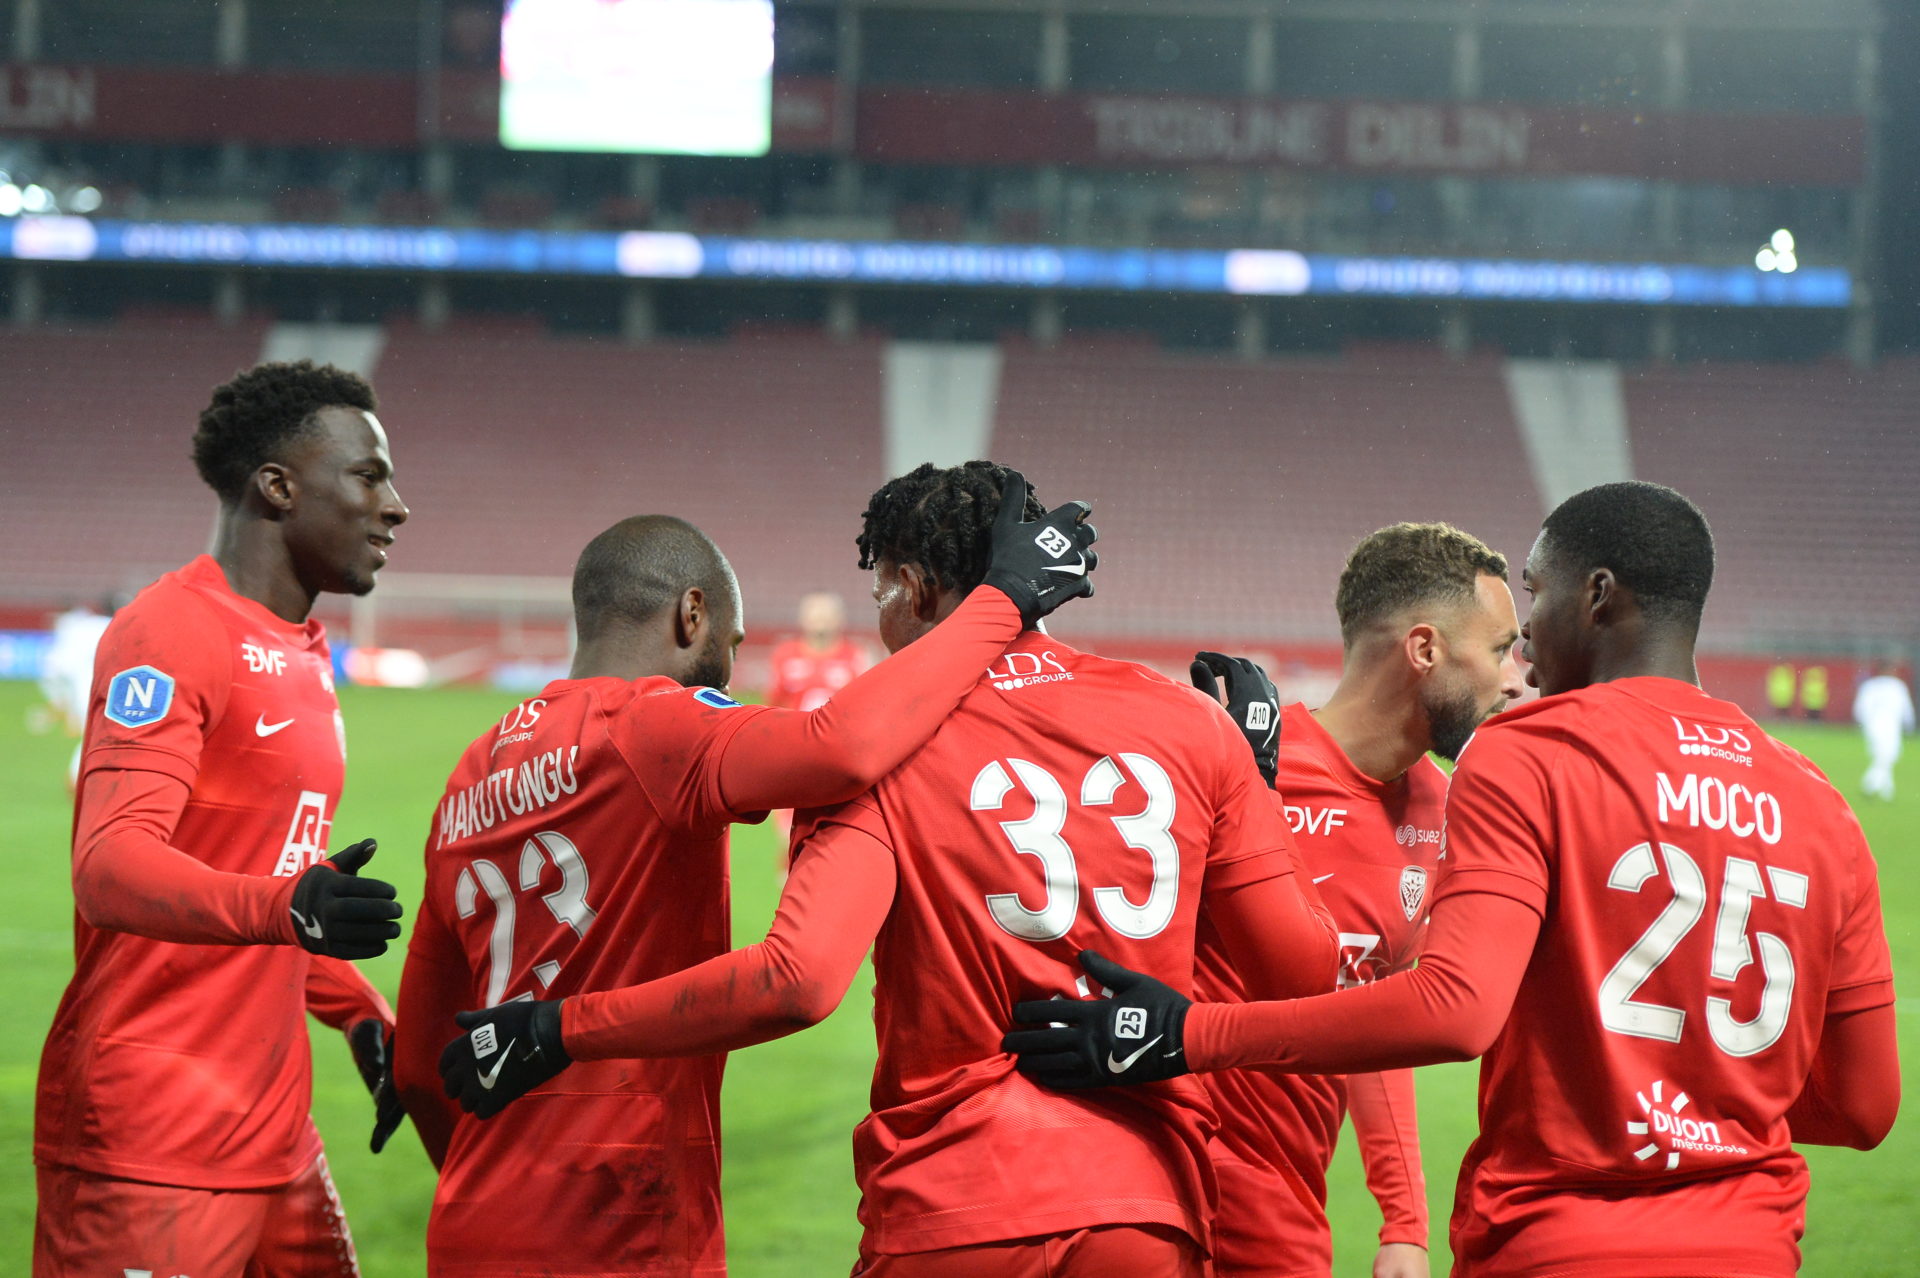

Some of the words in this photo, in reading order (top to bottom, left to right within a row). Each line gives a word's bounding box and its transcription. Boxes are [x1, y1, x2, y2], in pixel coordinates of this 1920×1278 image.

[1039, 530, 1066, 553] 23
[1023, 672, 1075, 686] GROUPE
[124, 676, 157, 708] N
[1250, 706, 1267, 725] A10
[1710, 746, 1753, 767] GROUPE
[436, 745, 579, 851] MAKUTUNGU
[1656, 772, 1782, 845] MOCO
[969, 752, 1180, 943] 33
[1598, 841, 1809, 1057] 25
[1120, 1011, 1142, 1036] 25
[474, 1029, 493, 1052] A10
[1671, 1137, 1749, 1155] métropole
